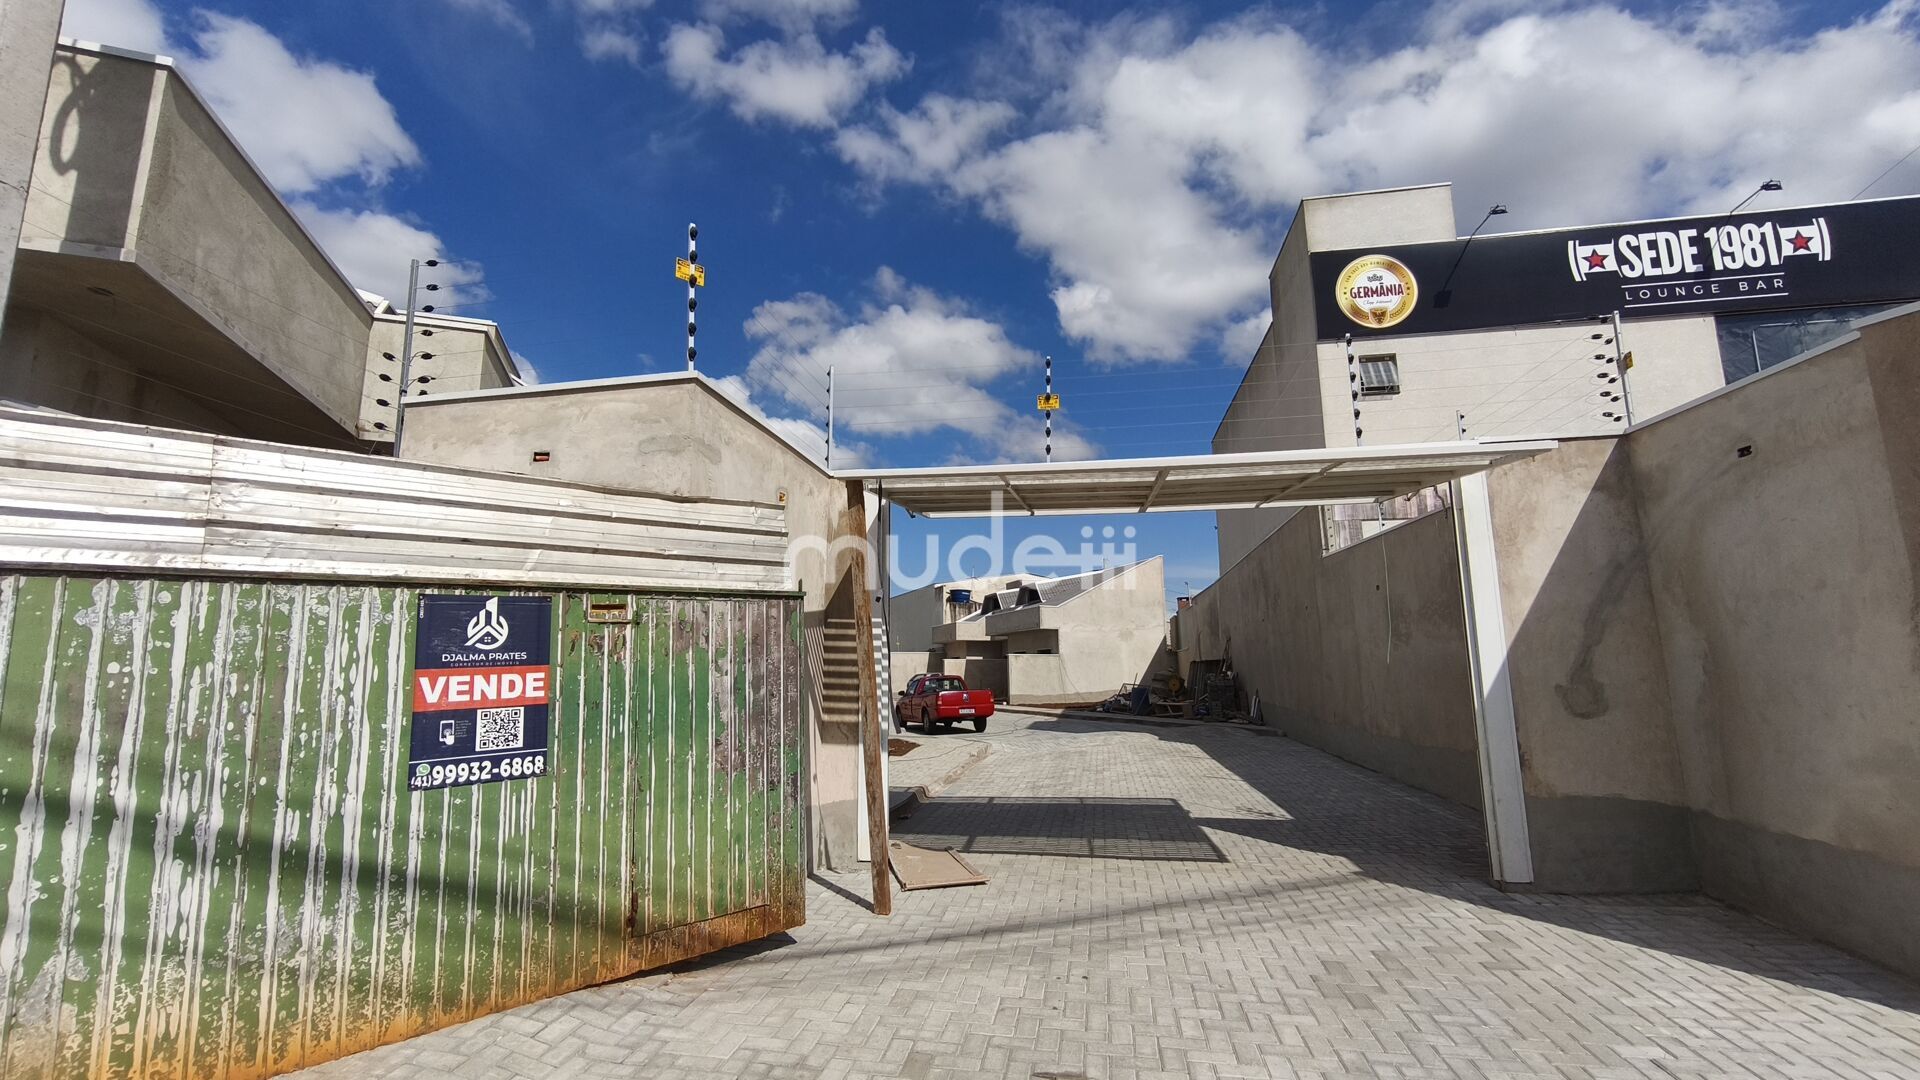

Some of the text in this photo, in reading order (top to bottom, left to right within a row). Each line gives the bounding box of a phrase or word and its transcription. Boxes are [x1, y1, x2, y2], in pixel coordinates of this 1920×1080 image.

[1618, 221, 1780, 278] SEDE 1981
[1625, 278, 1784, 300] LOUNGE BAR
[442, 652, 527, 662] DJALMA PRATES
[419, 672, 545, 703] VENDE
[432, 755, 544, 786] 99932-6868
